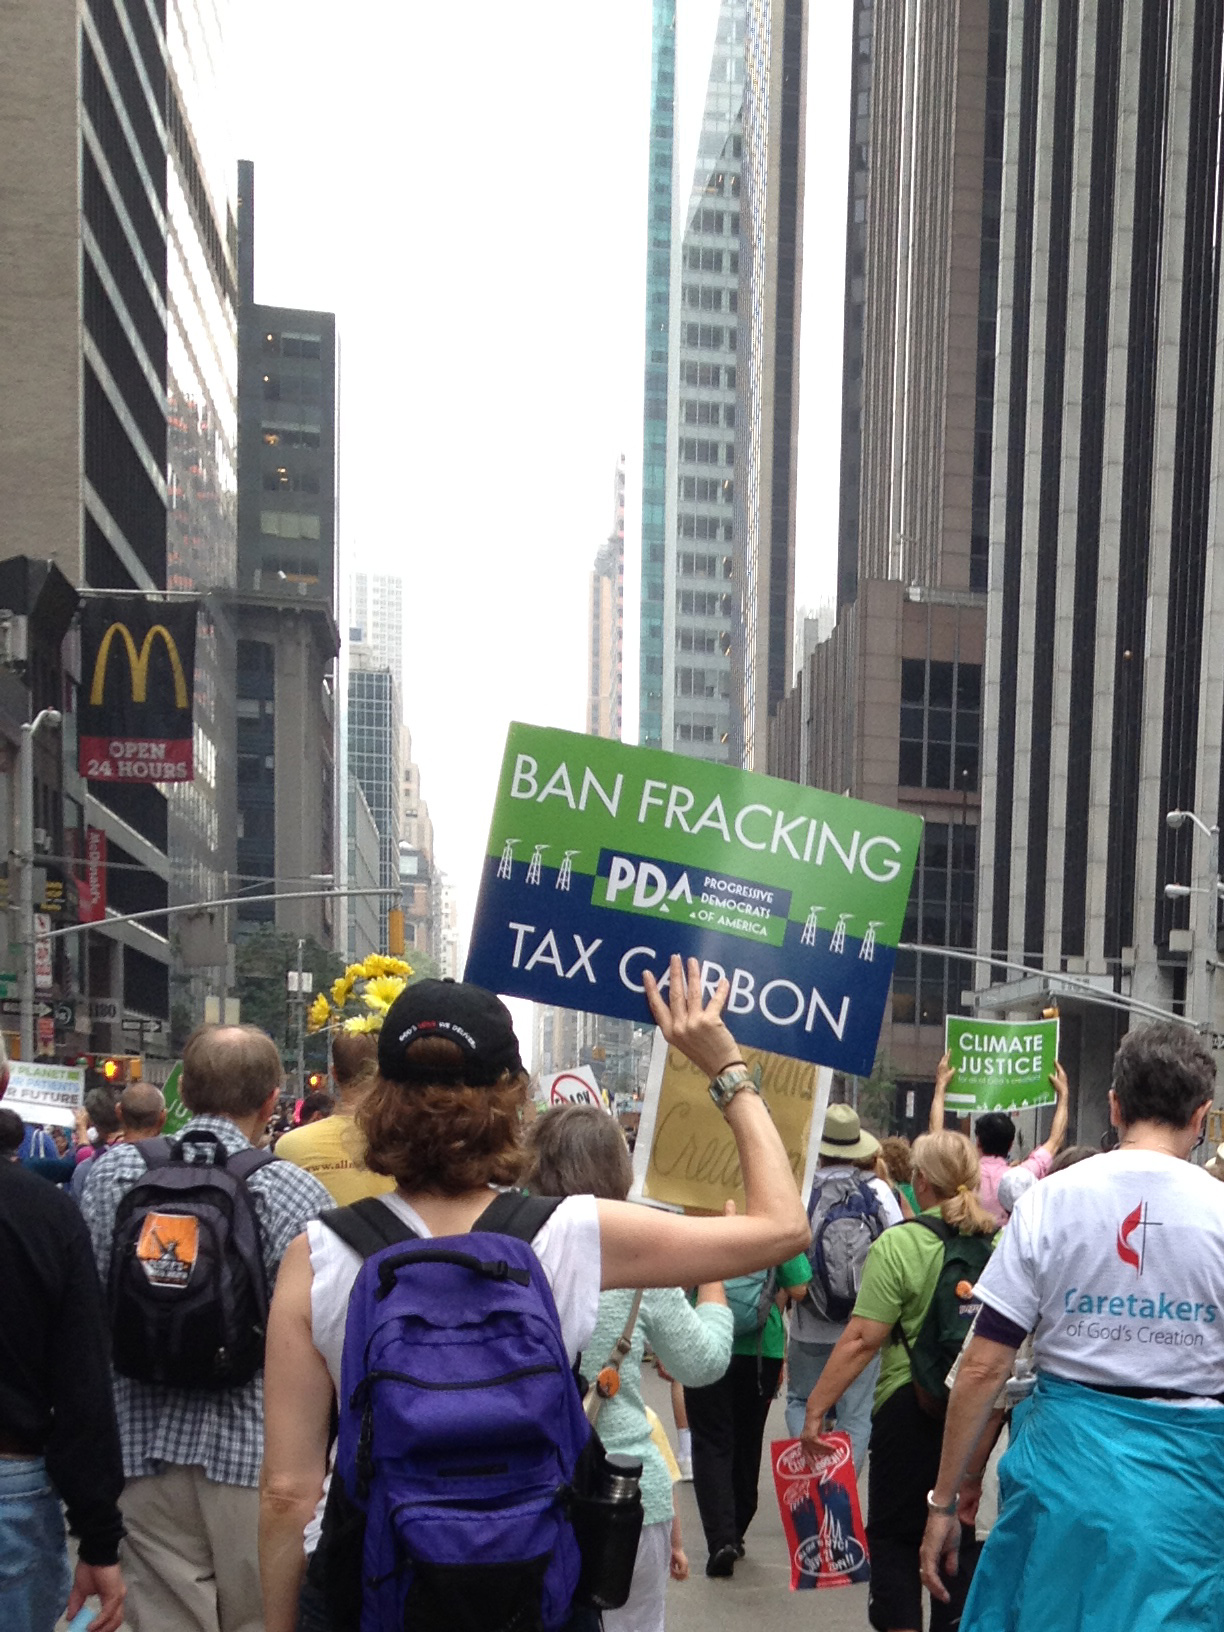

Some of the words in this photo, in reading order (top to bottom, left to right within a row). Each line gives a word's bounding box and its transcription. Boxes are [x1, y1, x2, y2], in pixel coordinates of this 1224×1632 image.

[109, 741, 166, 760] OPEN
[87, 759, 112, 776] 24
[118, 761, 187, 779] HOURS
[510, 754, 624, 818] BAN
[637, 778, 902, 882] FRACKING
[605, 855, 693, 913] PDA
[703, 875, 774, 904] PROGRESSIVE
[700, 892, 771, 919] DEMOCRATS
[698, 909, 714, 922] OF
[717, 915, 768, 936] AMERICA
[508, 922, 602, 984] TAX
[959, 1031, 1043, 1054] CLIMATE
[18, 1065, 67, 1081] PLANET
[957, 1055, 1043, 1076] JUSTICE
[21, 1089, 79, 1102] FUTURE
[1064, 1288, 1219, 1323] Caretakers
[1066, 1320, 1085, 1337] of
[1086, 1322, 1132, 1341] God's
[1137, 1326, 1204, 1346] Creation
